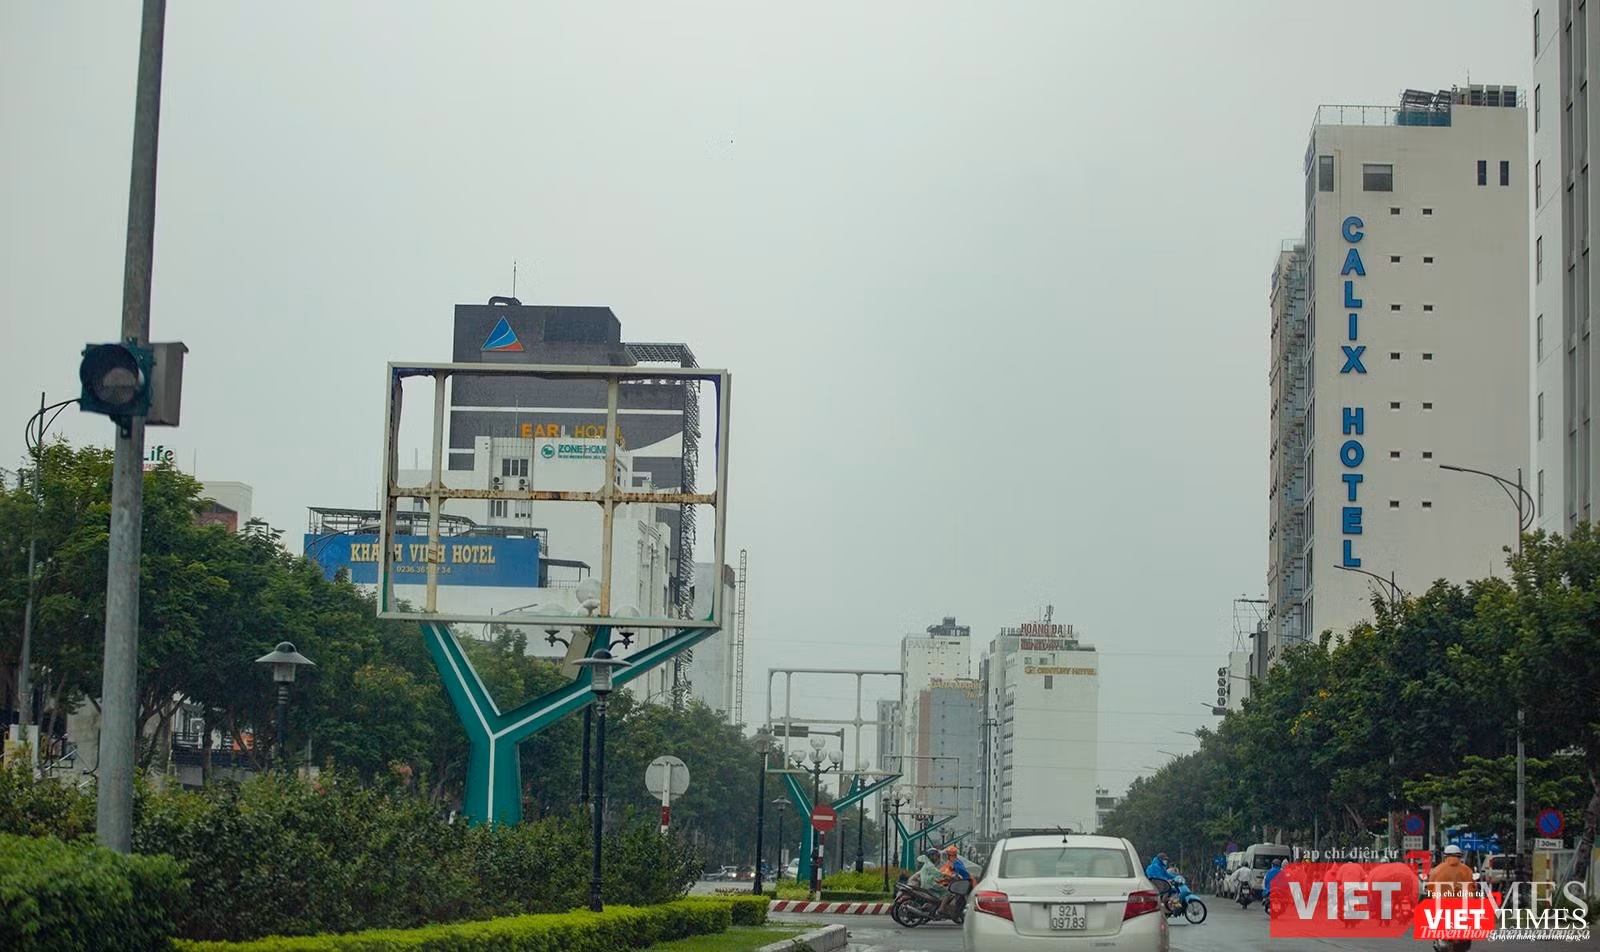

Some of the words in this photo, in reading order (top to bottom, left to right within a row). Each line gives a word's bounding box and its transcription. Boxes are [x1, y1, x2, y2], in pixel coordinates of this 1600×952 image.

[1340, 216, 1367, 374] CALIX
[575, 424, 623, 438] HOTL
[1340, 407, 1365, 567] HOTEL
[350, 538, 403, 562] KHÁH
[409, 543, 446, 563] VIH
[451, 545, 497, 564] HOTEL
[1058, 905, 1078, 917] 92A
[1051, 917, 1086, 929] 097.83
